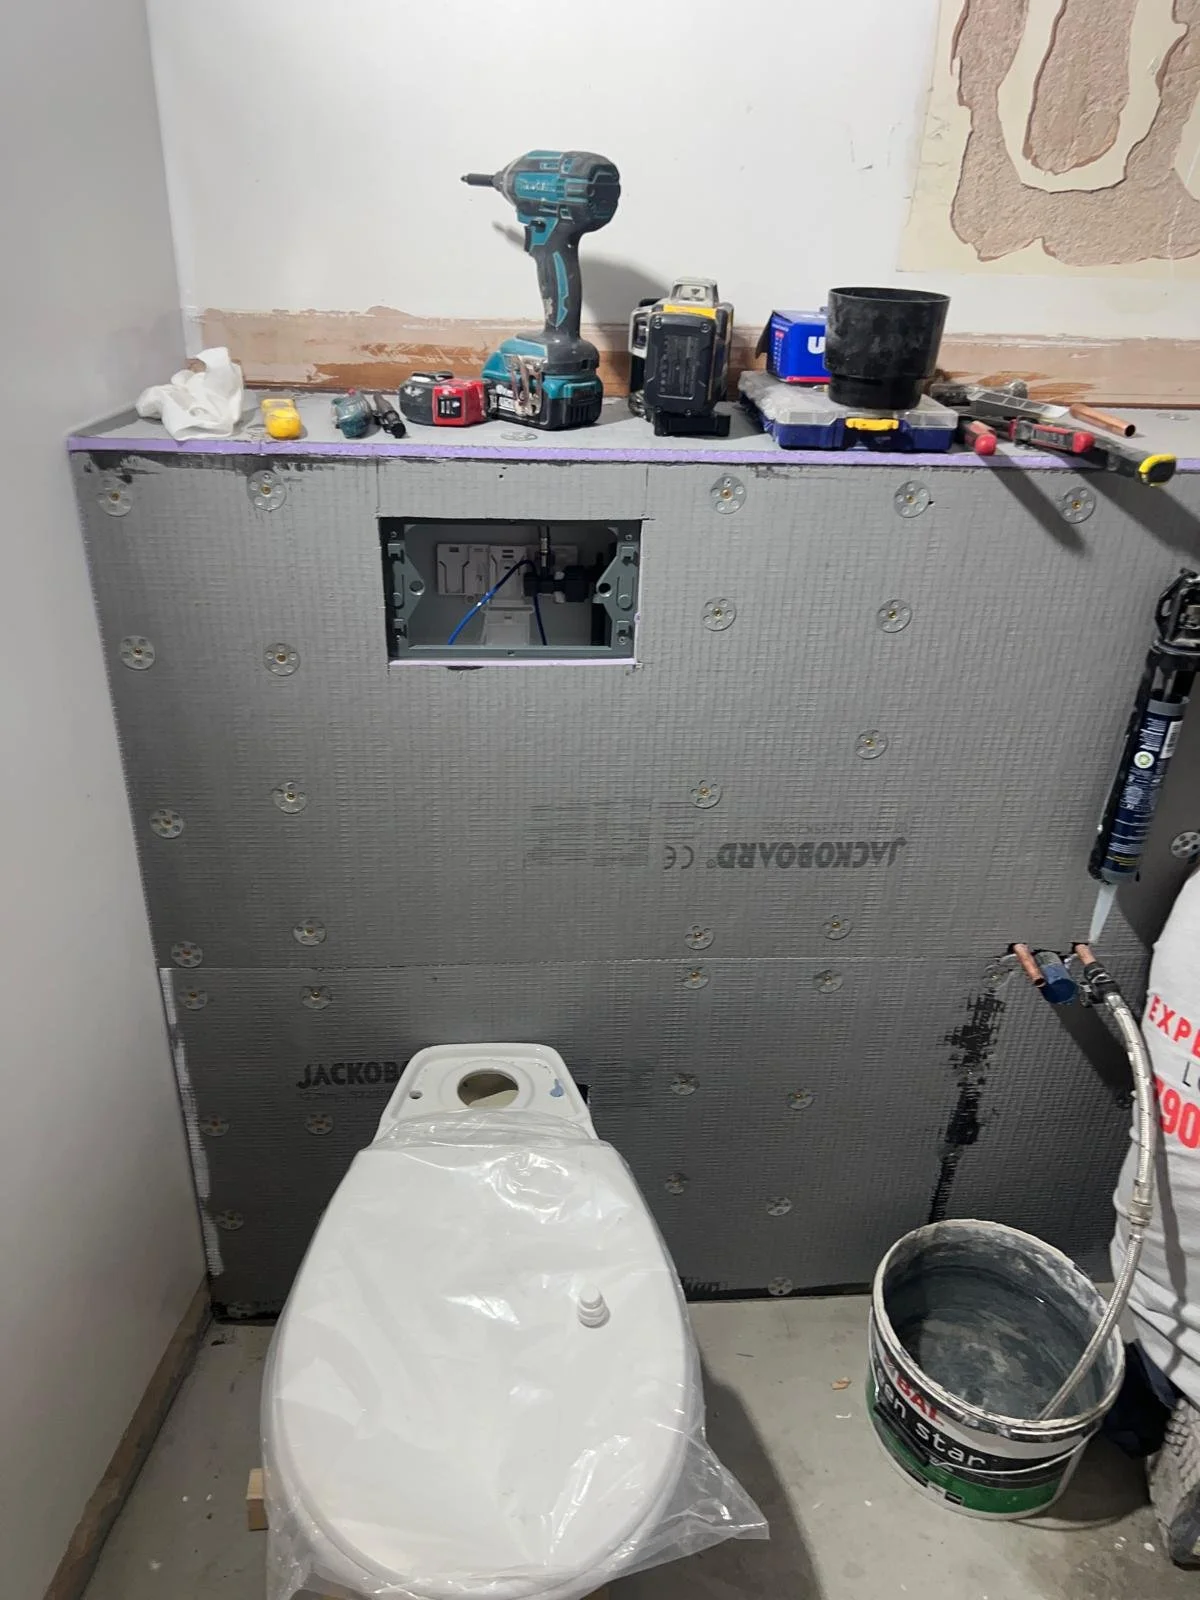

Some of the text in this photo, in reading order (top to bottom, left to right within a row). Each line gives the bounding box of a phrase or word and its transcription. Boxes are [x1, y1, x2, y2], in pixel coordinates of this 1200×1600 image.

[714, 837, 905, 869] JACKOBOARD
[294, 1060, 408, 1089] JACKOB
[1153, 1075, 1200, 1149] 90
[896, 1376, 945, 1427] BAL
[913, 1421, 987, 1467] star
